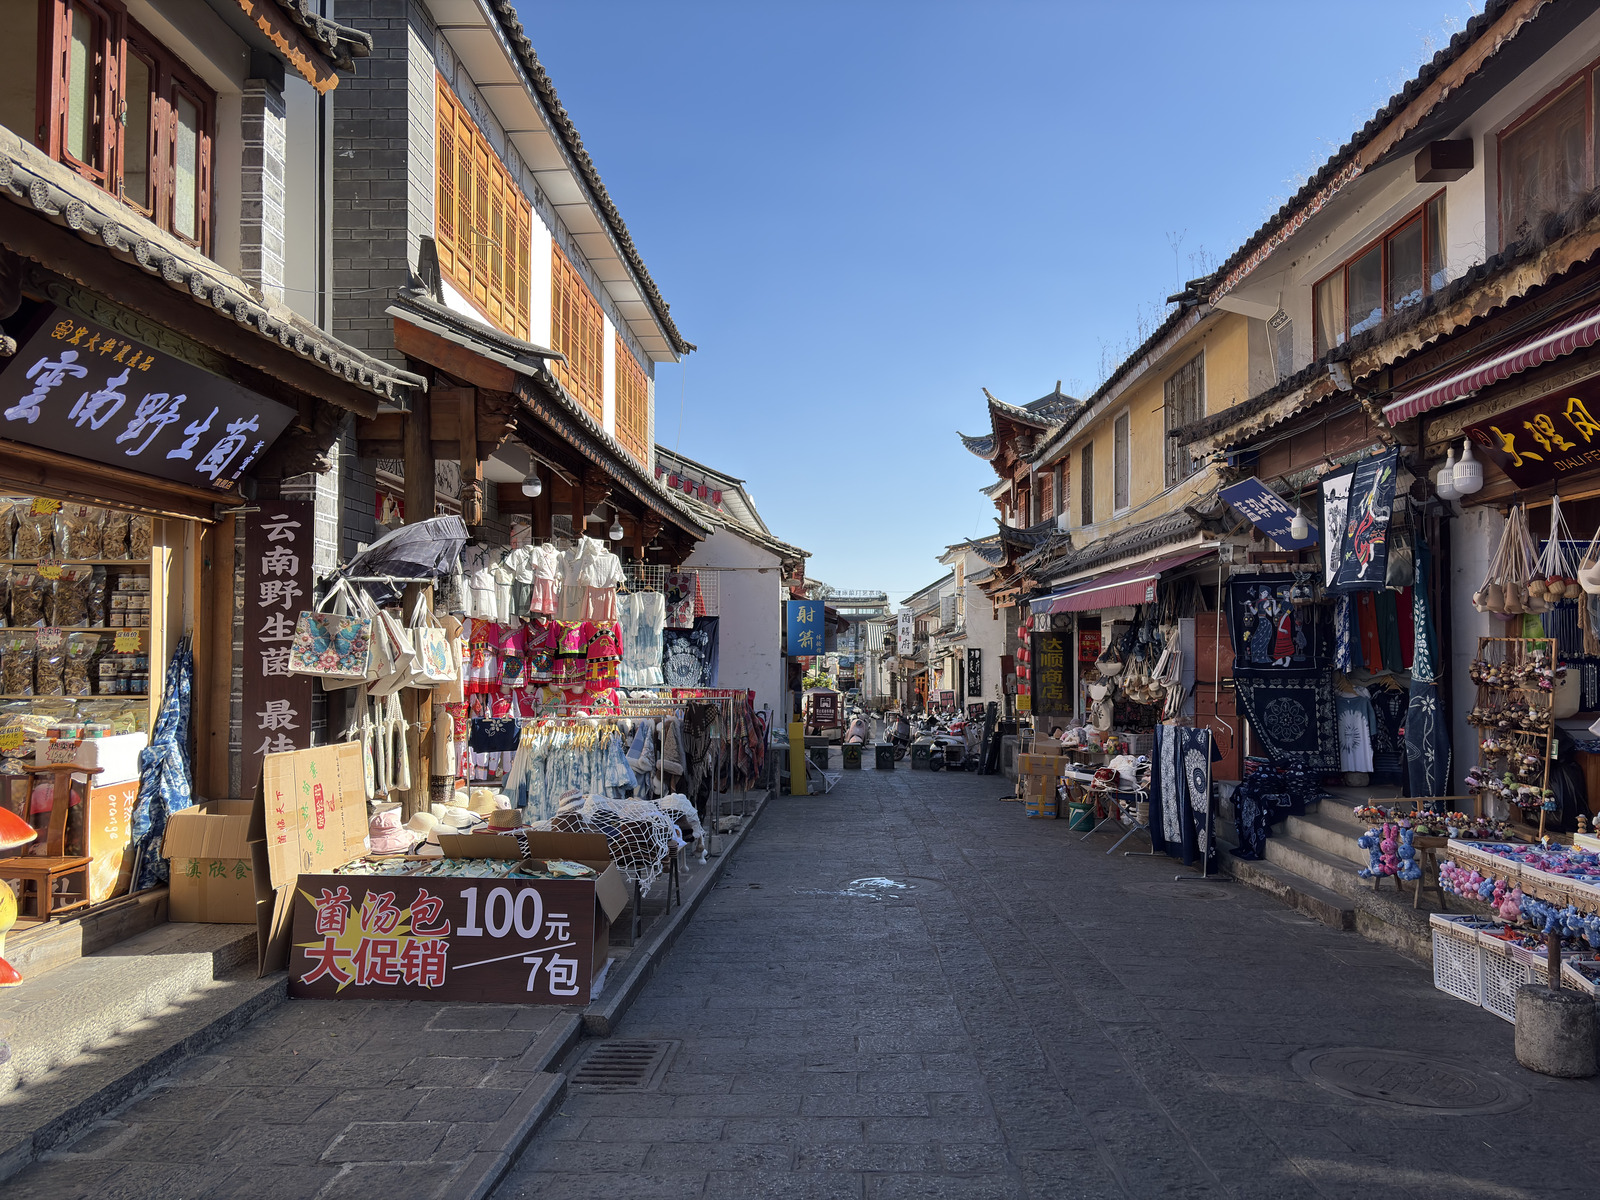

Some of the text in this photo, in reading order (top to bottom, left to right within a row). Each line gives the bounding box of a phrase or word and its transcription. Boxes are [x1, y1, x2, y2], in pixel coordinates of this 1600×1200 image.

[1583, 448, 1600, 463] FE
[257, 513, 303, 678] 云南野生菌
[796, 605, 817, 650] 射箭
[1040, 637, 1064, 700] 达顺商店
[104, 794, 119, 840] orange
[185, 857, 253, 880] 滇欣食
[313, 884, 451, 937] 菌汤包
[455, 886, 571, 942] 100元
[301, 937, 449, 988] 大促销
[522, 952, 580, 997] 7包
